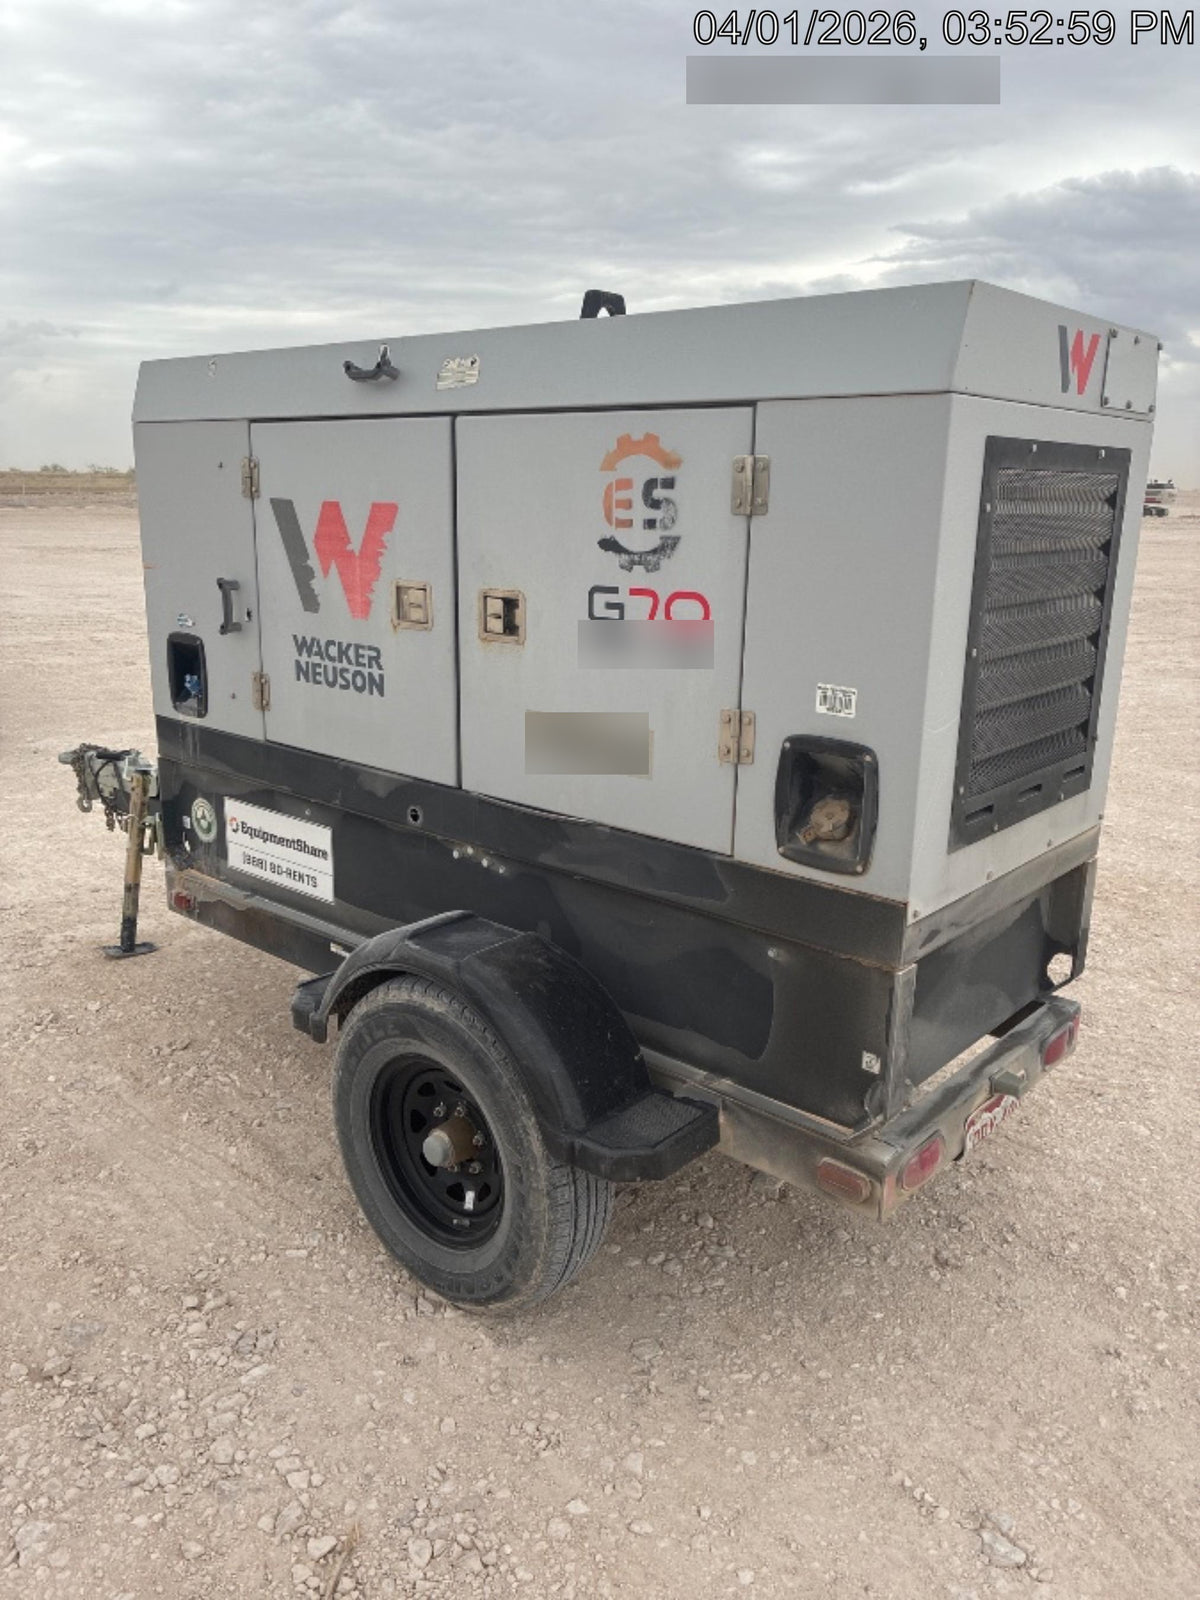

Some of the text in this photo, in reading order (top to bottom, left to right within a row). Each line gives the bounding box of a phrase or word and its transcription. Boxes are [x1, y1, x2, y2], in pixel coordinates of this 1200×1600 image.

[292, 634, 384, 670] WACKER
[294, 660, 385, 697] NEUSON
[241, 821, 328, 861] EquipmentShare
